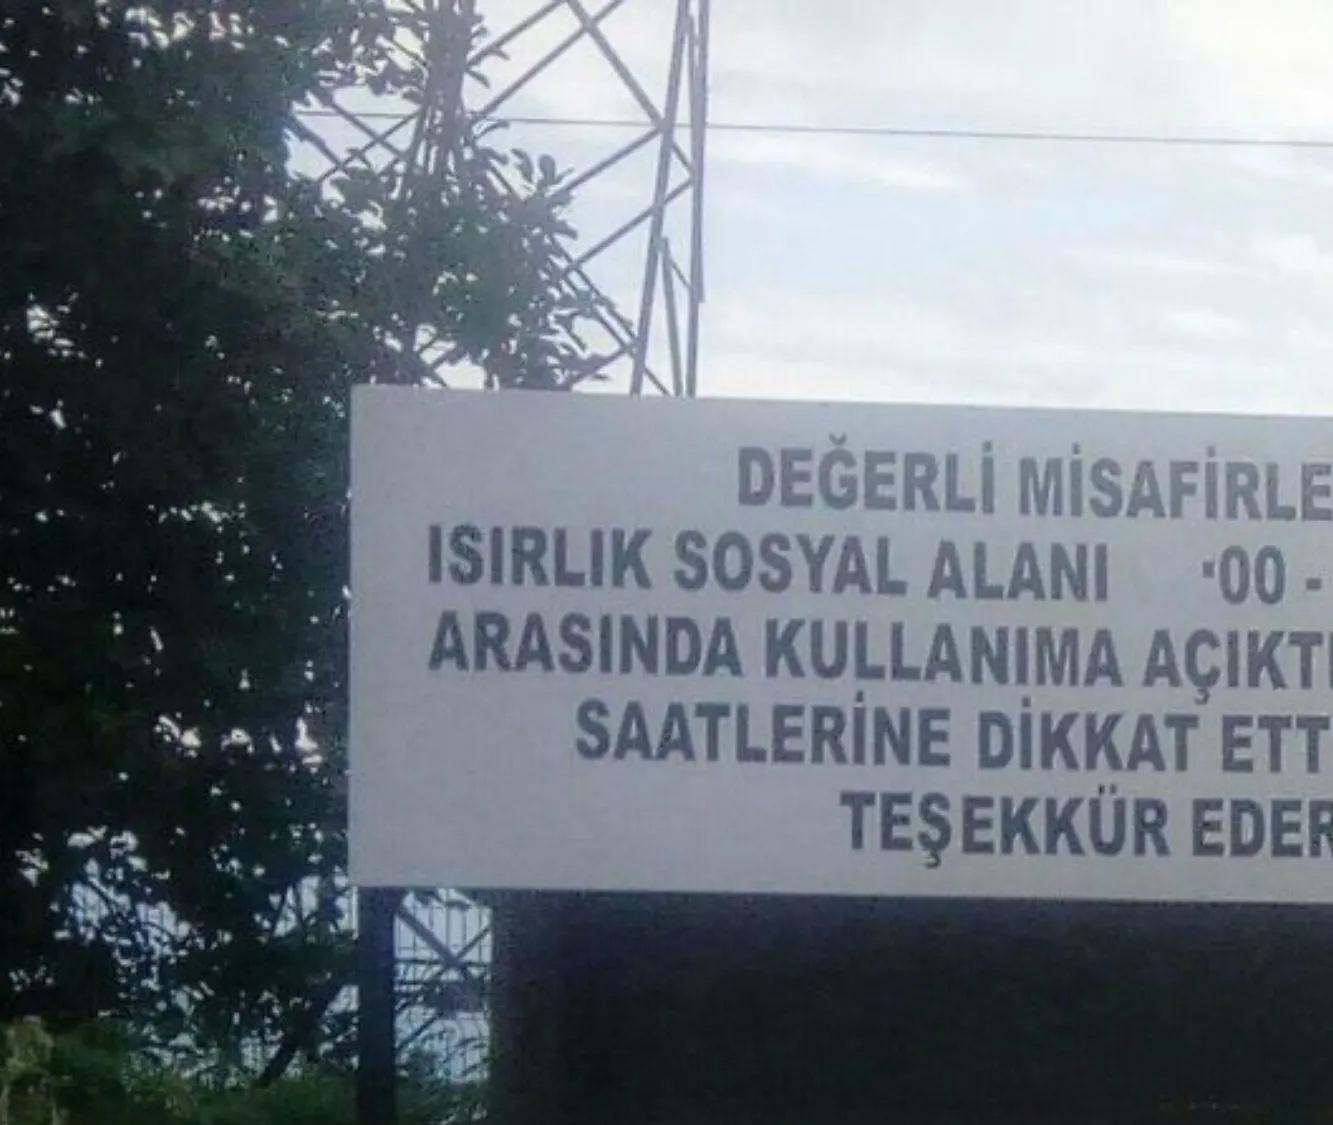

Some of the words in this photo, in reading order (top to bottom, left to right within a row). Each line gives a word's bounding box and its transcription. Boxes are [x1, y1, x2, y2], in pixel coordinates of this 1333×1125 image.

[738, 432, 995, 510] DEĞERLİ
[429, 524, 651, 589] ISIRLIK
[673, 530, 908, 597] SOSYAL
[927, 539, 1108, 602] ALANI
[427, 610, 742, 677] ARASINDA
[765, 617, 1124, 688] KULLANIMA
[575, 691, 951, 767] SAATLERİNE
[978, 697, 1198, 772] DİKKAT
[840, 785, 1169, 868] TEŞEKKÜR
